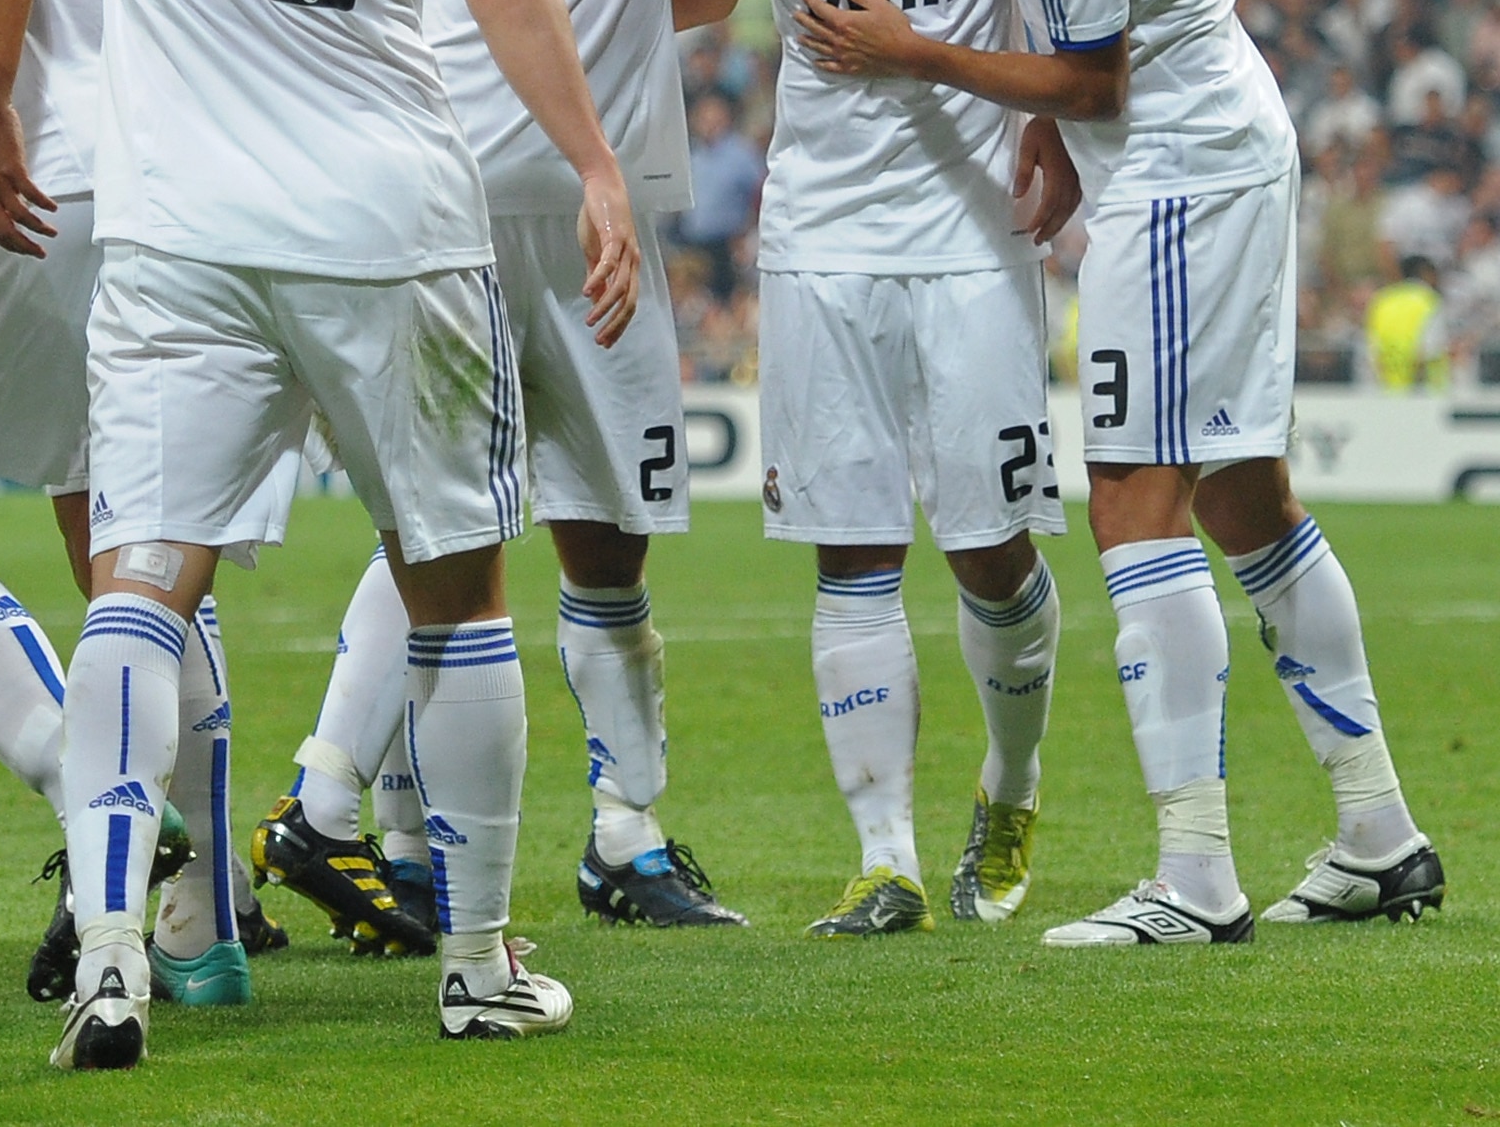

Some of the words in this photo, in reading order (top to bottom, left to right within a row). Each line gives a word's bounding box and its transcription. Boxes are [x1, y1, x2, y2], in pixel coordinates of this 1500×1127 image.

[1090, 349, 1128, 429] 3
[1201, 425, 1241, 437] adidas
[640, 425, 675, 502] 2
[88, 792, 156, 817] adidas
